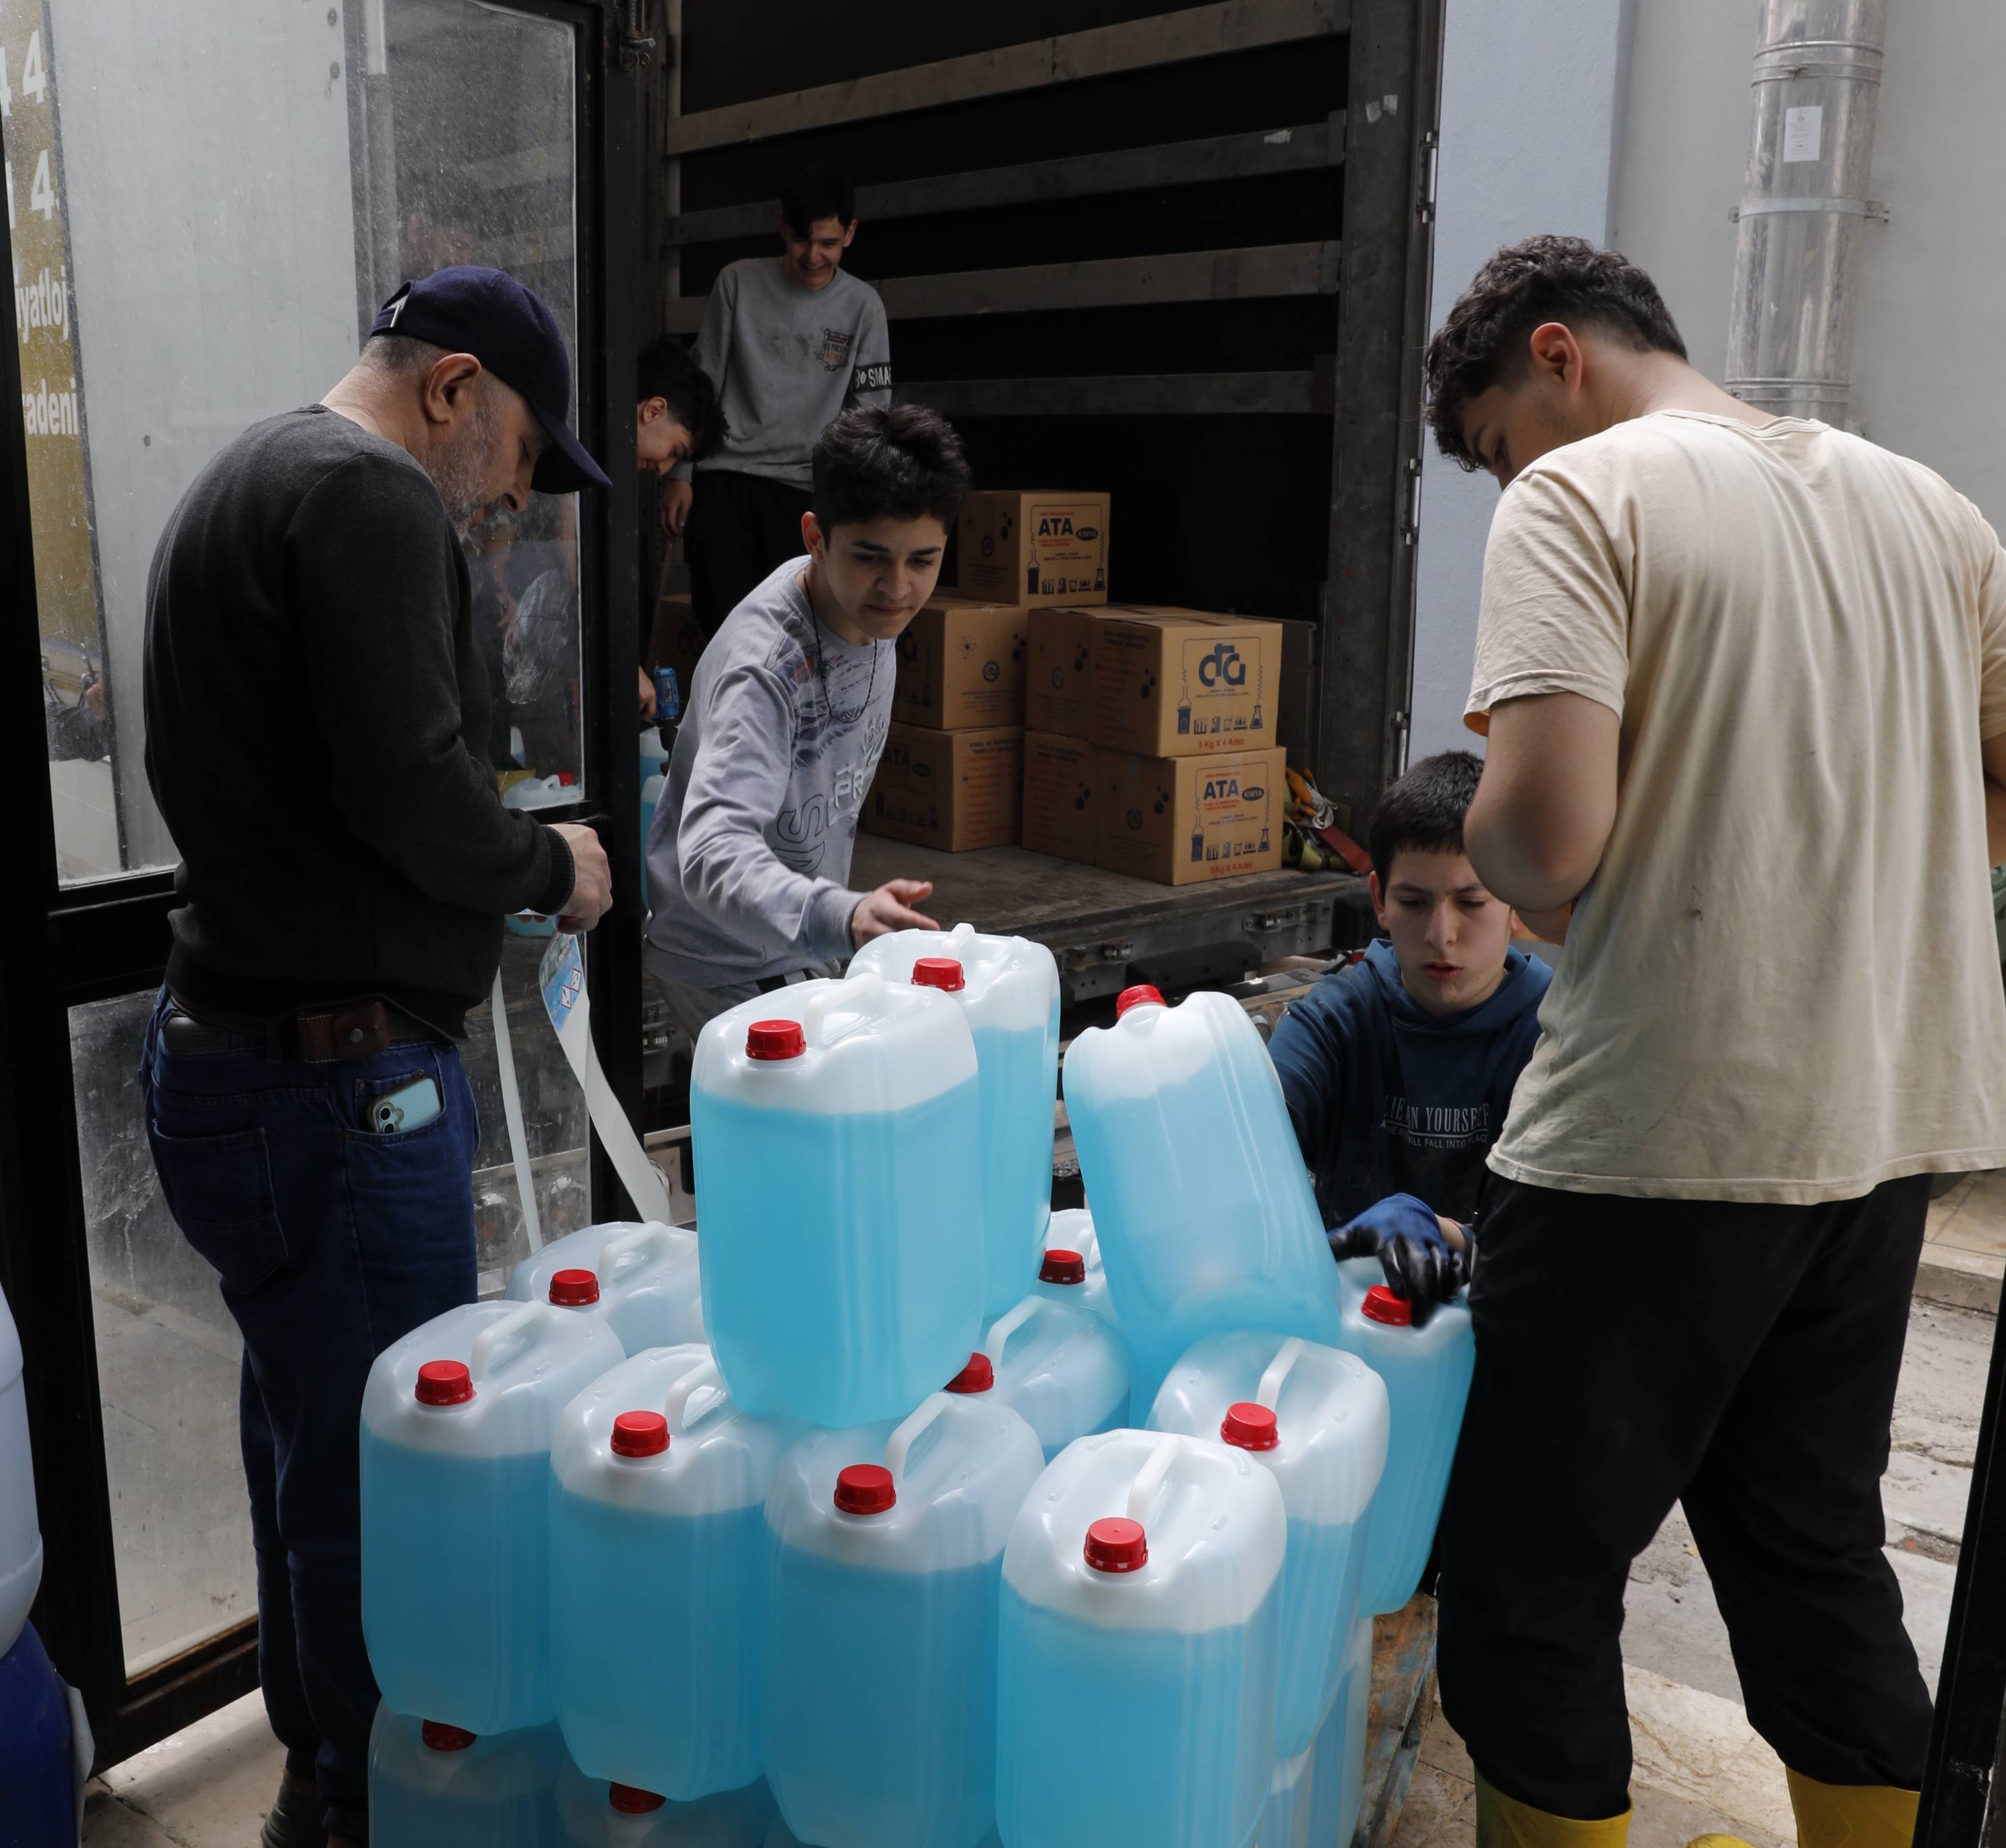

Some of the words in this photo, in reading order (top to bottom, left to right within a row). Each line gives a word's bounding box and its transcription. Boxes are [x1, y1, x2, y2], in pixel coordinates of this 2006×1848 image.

[1037, 518, 1074, 536] ATA
[1204, 740, 1214, 750] Kg
[1228, 737, 1245, 747] Adet
[1203, 778, 1240, 801] ATA
[1238, 862, 1252, 870] Adet
[1424, 1138, 1445, 1149] FALL
[1446, 1138, 1467, 1149] INTO
